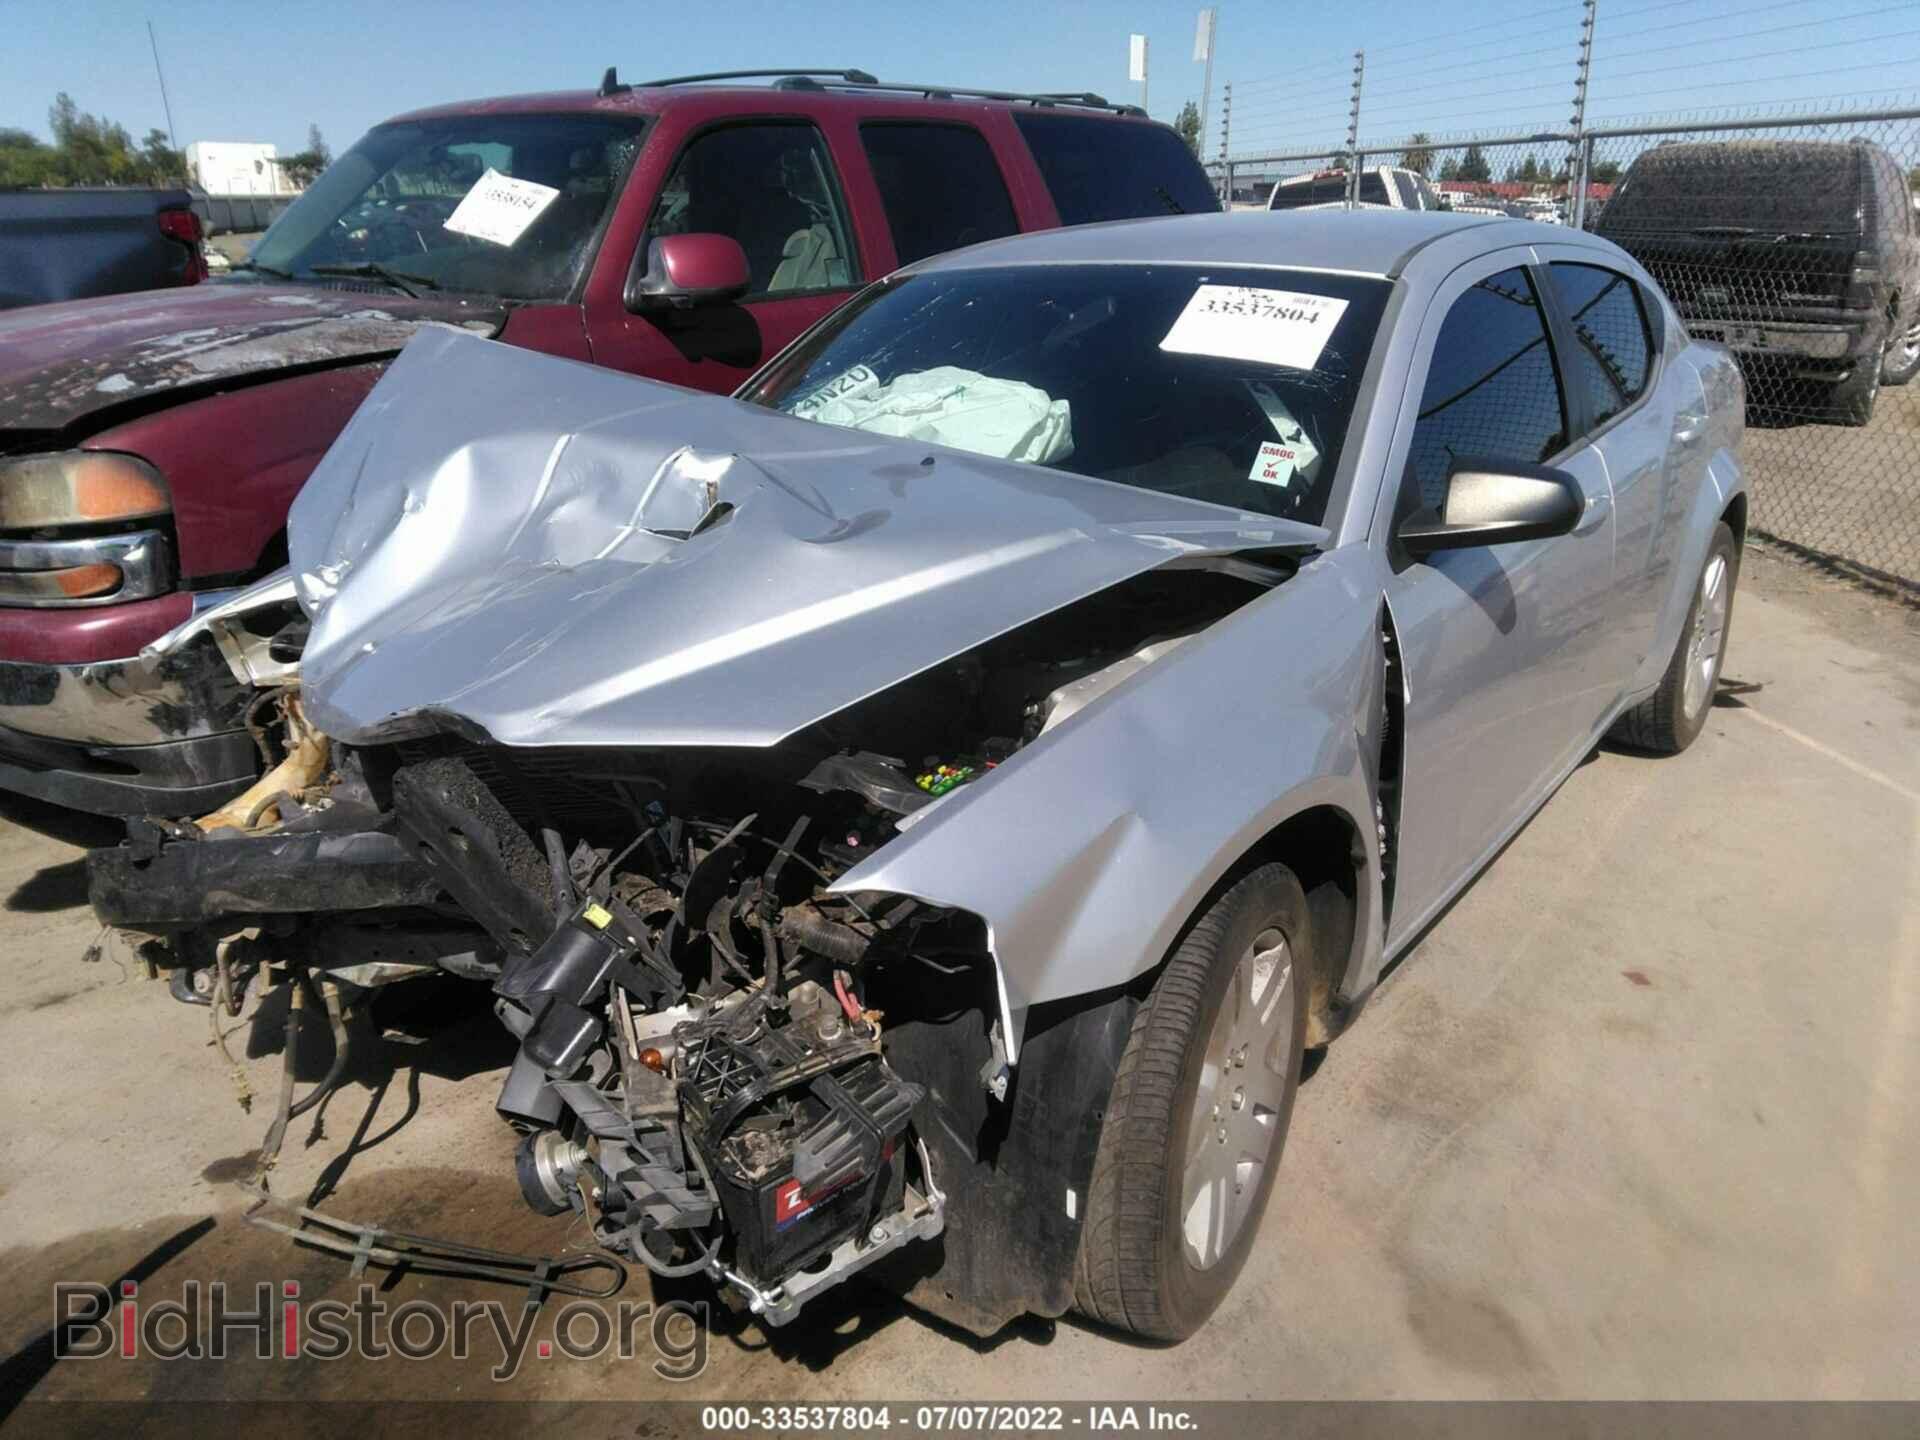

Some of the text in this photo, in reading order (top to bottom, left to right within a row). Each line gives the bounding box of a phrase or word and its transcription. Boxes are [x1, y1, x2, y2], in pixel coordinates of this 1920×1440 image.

[1199, 299, 1320, 324] 33537804
[1262, 446, 1296, 460] SMOG
[1262, 469, 1279, 480] OK
